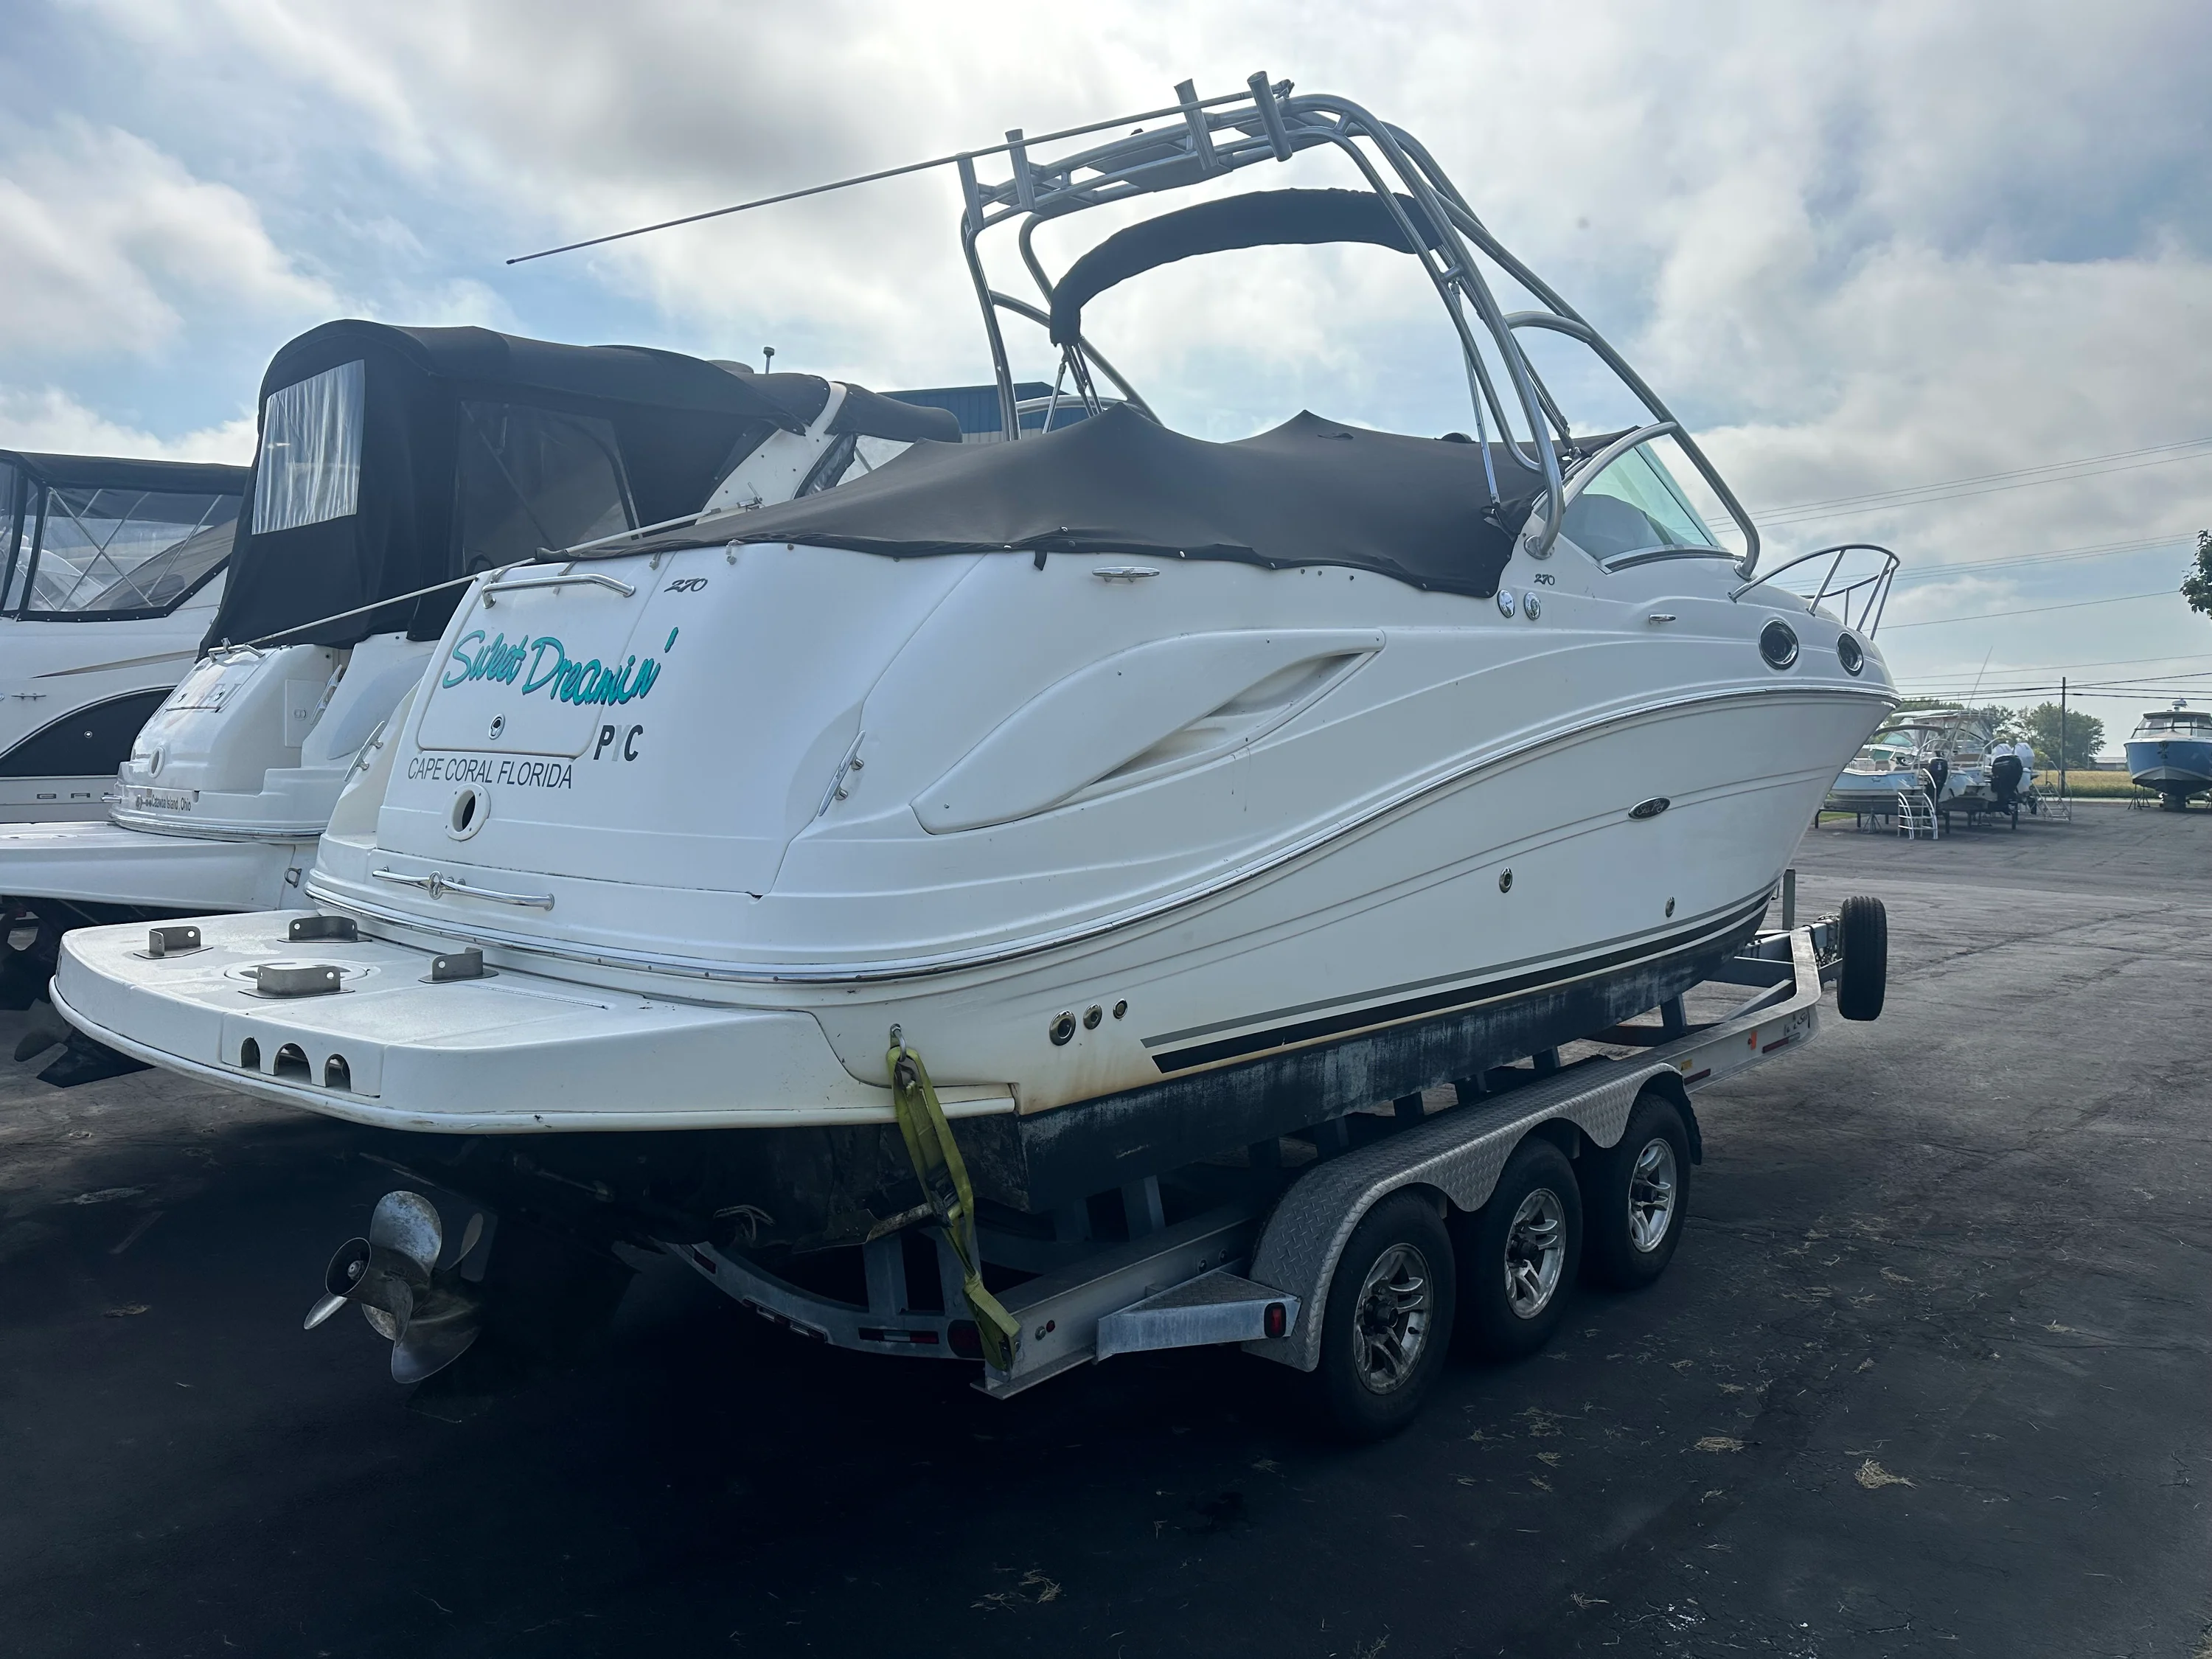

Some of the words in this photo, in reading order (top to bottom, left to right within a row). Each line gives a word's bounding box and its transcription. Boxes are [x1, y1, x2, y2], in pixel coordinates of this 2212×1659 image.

[664, 577, 709, 593] 270
[1534, 573, 1555, 586] 270
[442, 630, 527, 689] Sweet
[593, 724, 644, 762] PYC
[408, 757, 444, 781] CAPE
[445, 758, 493, 784] CORAL
[496, 760, 572, 790] FLORIDA
[180, 797, 192, 812] Ohio
